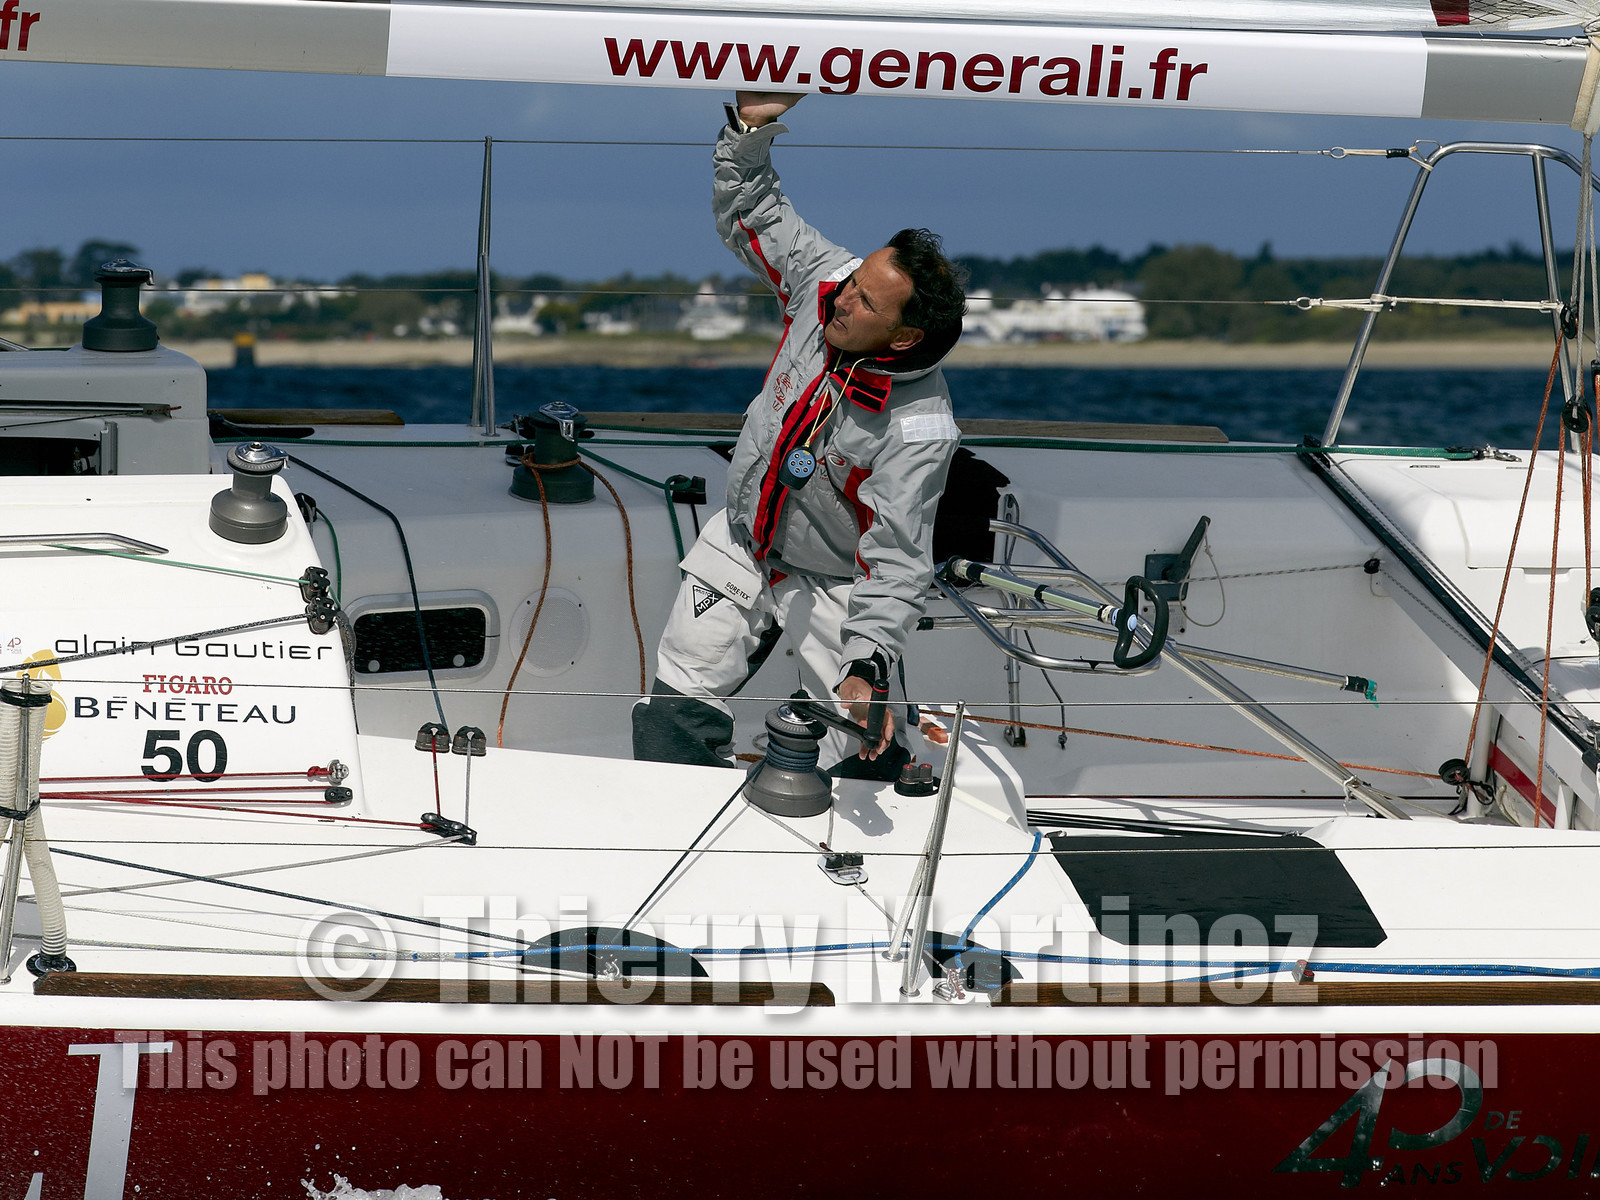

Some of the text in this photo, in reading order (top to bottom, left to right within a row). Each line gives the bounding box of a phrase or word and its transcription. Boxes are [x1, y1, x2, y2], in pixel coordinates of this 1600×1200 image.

[604, 36, 1209, 101] www.generali.fr
[695, 593, 719, 613] MPX
[175, 638, 332, 660] Gautier
[142, 674, 233, 695] FIGARO
[140, 729, 228, 783] 50
[1484, 1110, 1523, 1130] DE
[1379, 1133, 1600, 1188] ANS VOI
